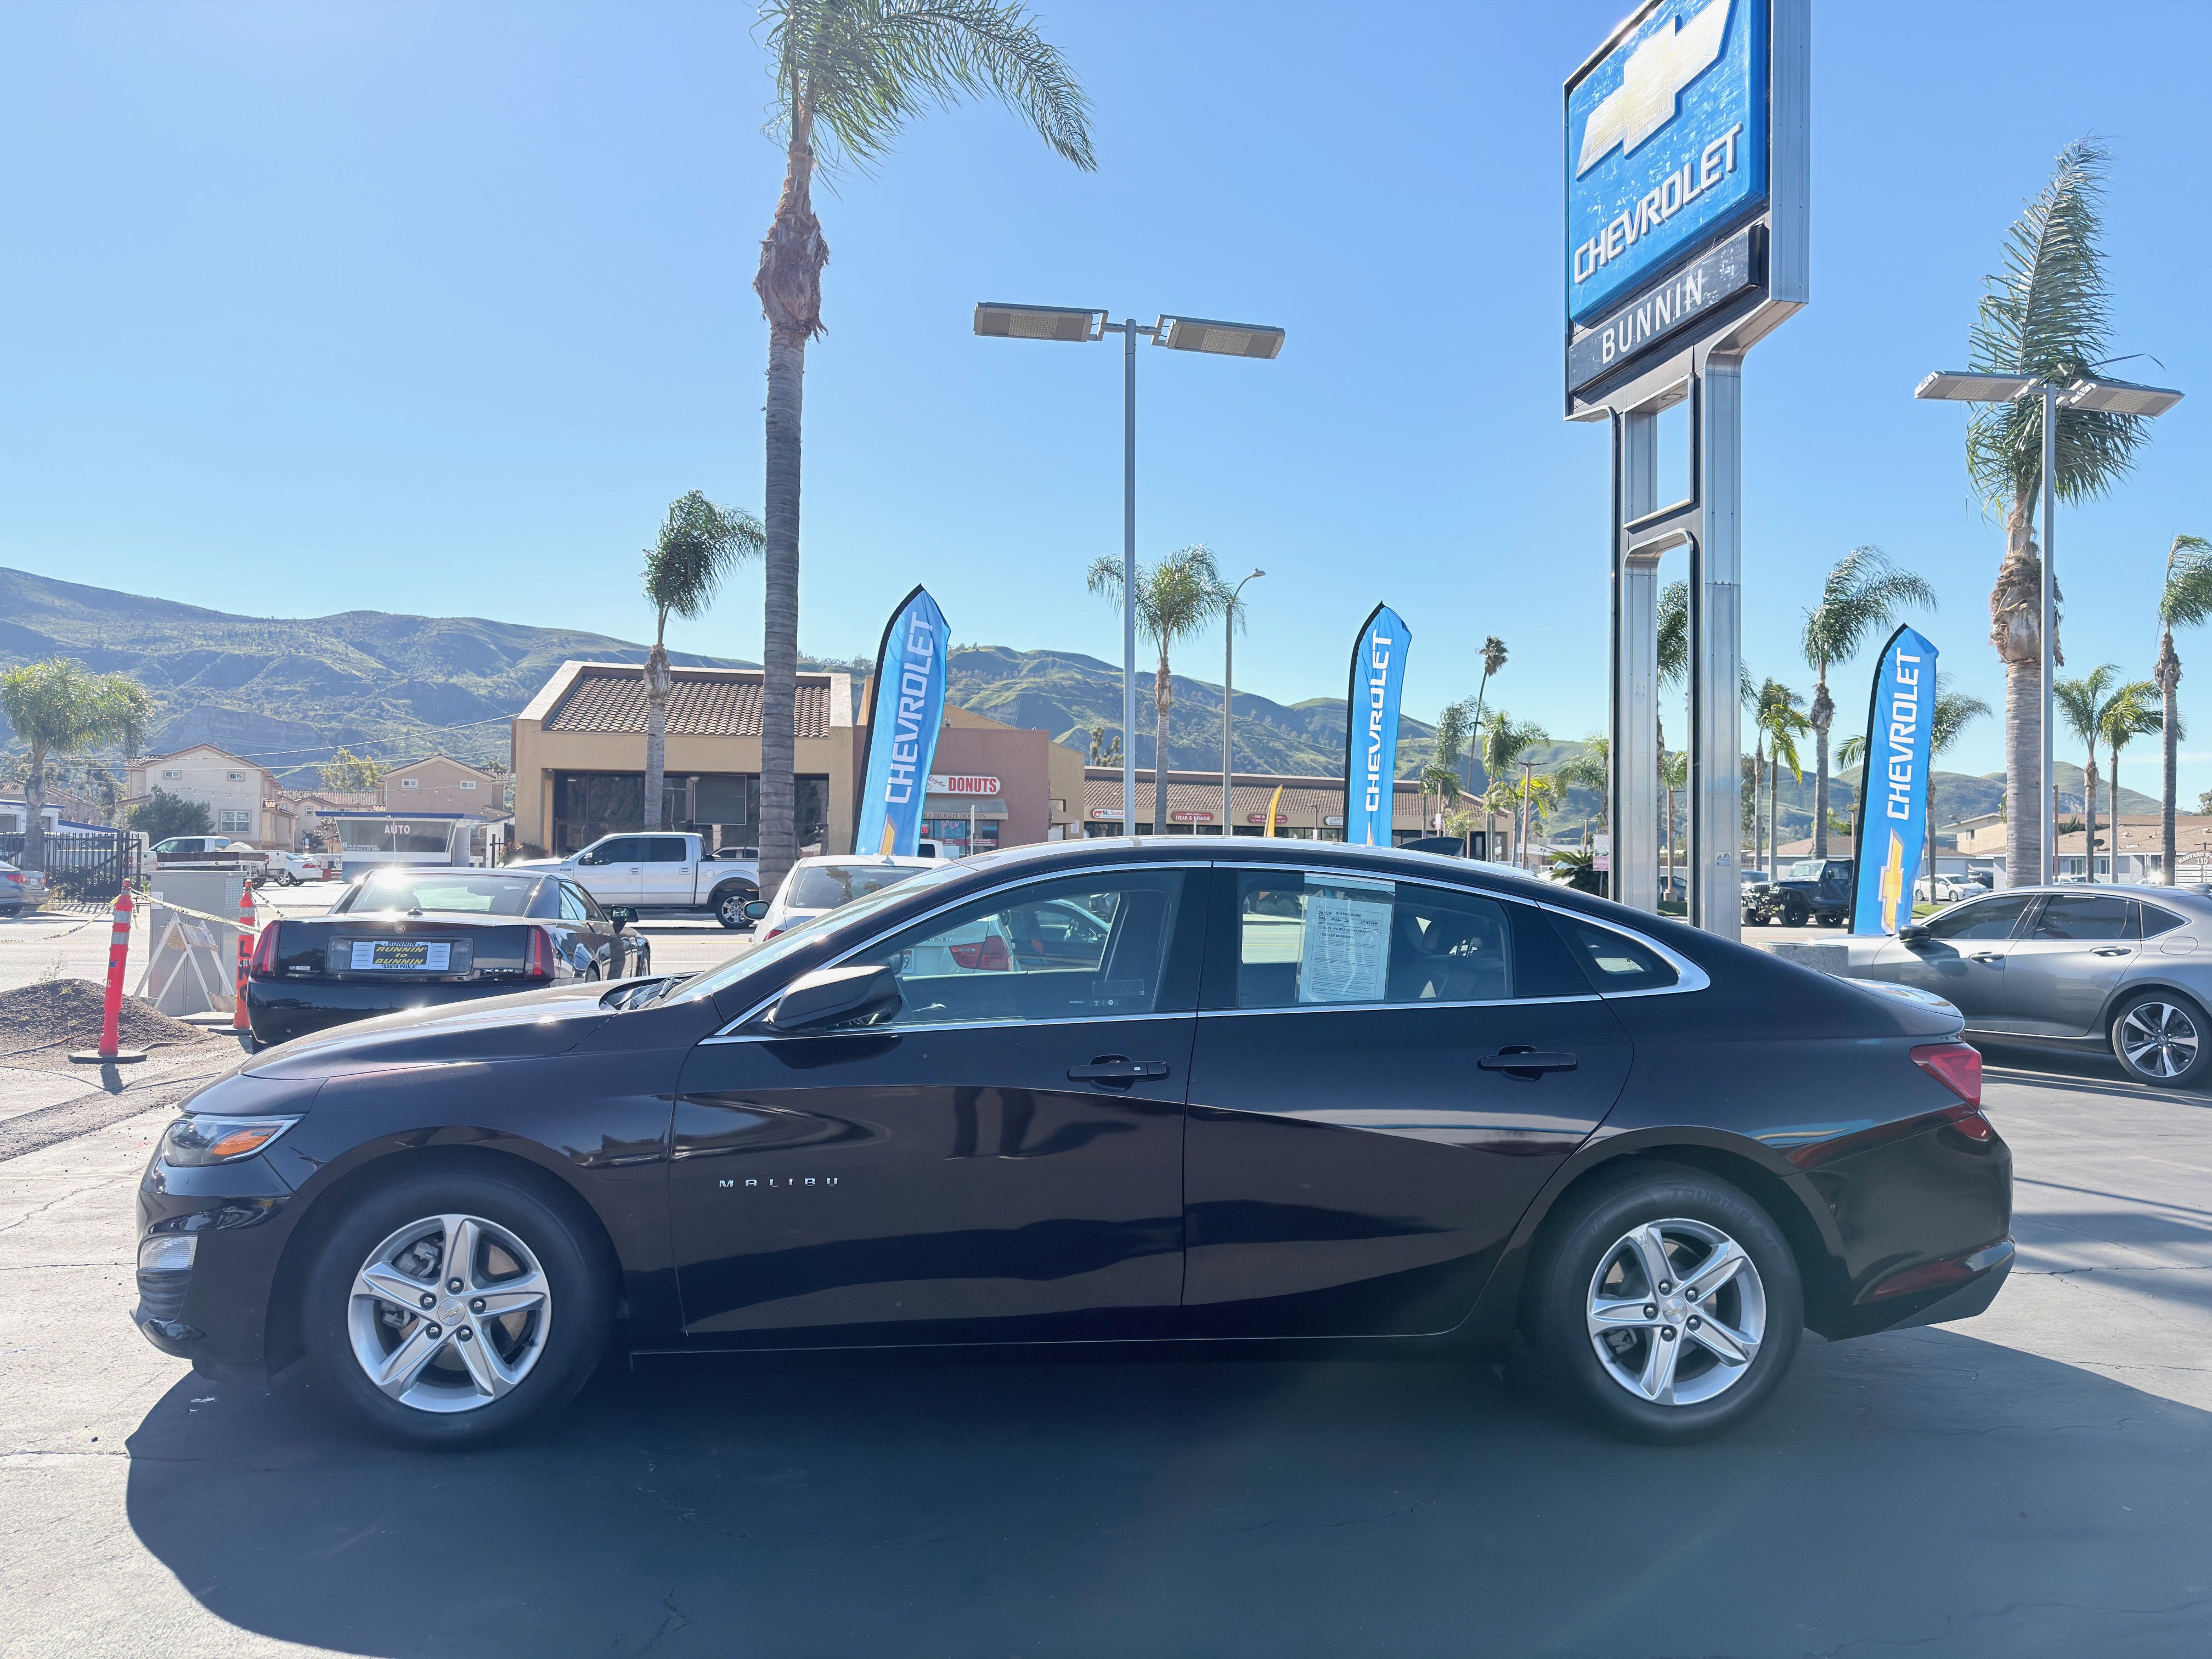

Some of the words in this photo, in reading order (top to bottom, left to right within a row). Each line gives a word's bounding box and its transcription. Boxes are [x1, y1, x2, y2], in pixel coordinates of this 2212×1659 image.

[1574, 122, 1742, 285] CHEVROLET
[1602, 270, 1703, 365] BUNNIN
[884, 612, 934, 804] CHEVROLET
[1365, 629, 1393, 812] CHEVROLET
[1887, 647, 1921, 820] CHEVROLET
[384, 825, 410, 834] AUTO
[948, 777, 997, 793] DONUTS
[2178, 852, 2204, 864] HARVARD
[719, 1178, 838, 1188] MALIBU
